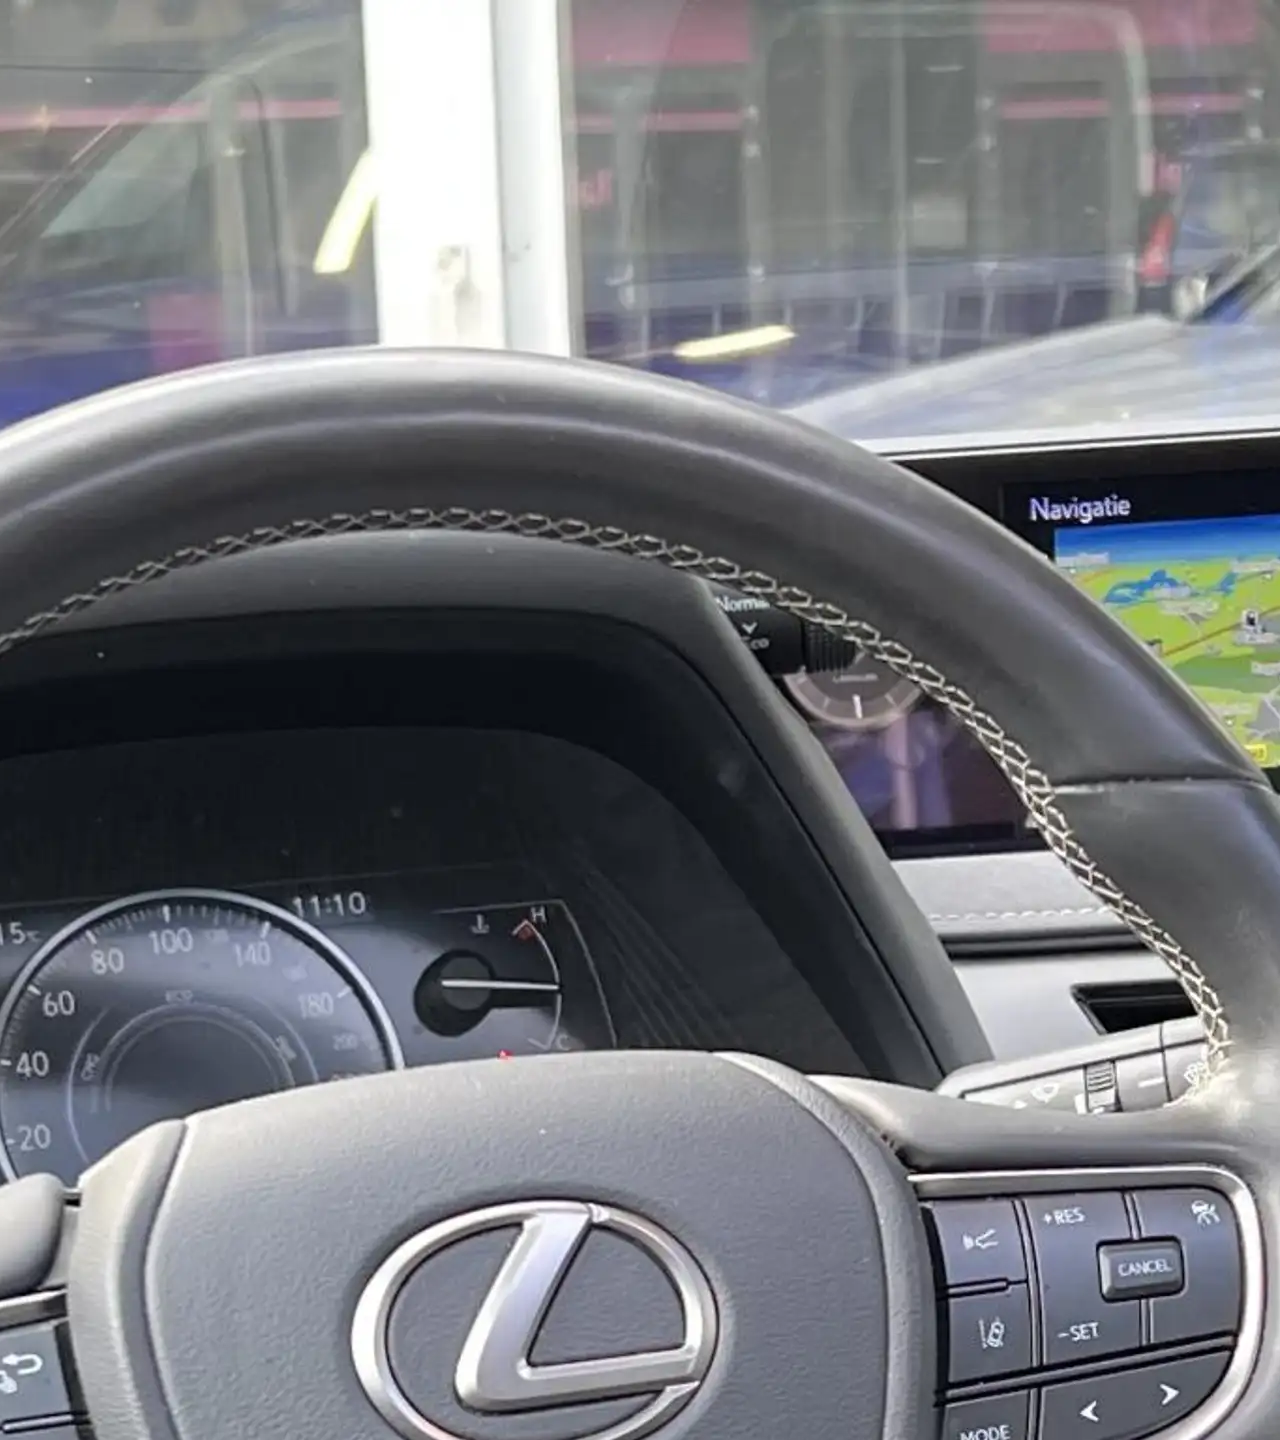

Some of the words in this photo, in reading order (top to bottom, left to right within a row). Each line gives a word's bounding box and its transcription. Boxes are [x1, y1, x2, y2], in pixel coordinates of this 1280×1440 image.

[1029, 495, 1131, 523] Navigatie
[292, 892, 366, 920] 11:10
[531, 906, 546, 922] H
[148, 927, 193, 954] 100
[90, 948, 125, 975] 80
[235, 941, 271, 968] 140
[42, 990, 75, 1017] 60
[15, 1050, 50, 1078] 40
[19, 1124, 51, 1152] 20
[1118, 1257, 1173, 1277] CANCEL
